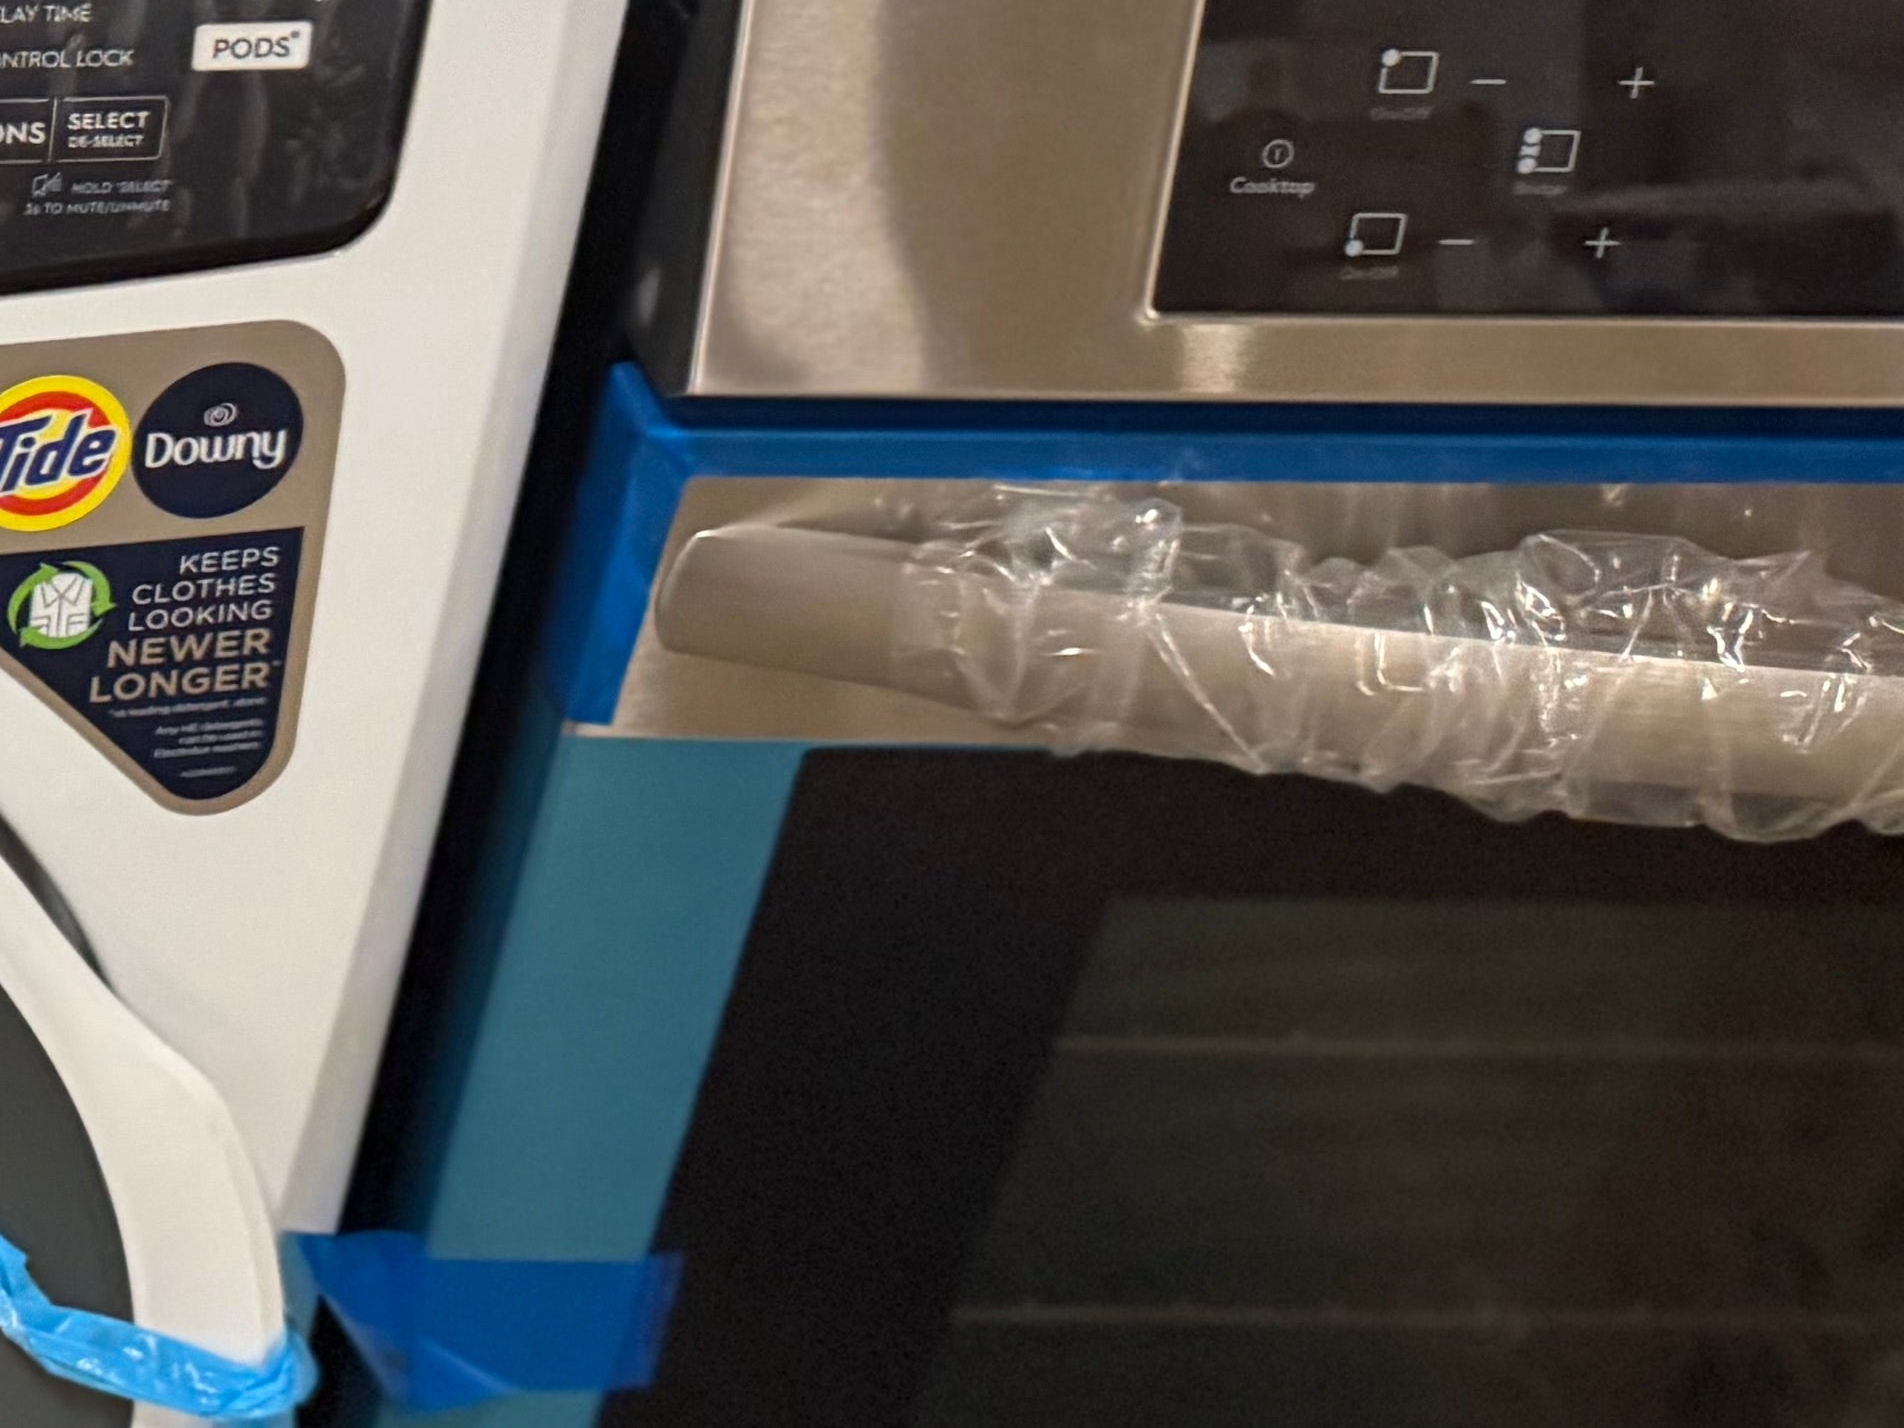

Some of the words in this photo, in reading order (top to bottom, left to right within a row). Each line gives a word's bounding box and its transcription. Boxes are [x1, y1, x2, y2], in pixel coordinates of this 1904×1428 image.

[43, 3, 93, 22] TIME
[76, 49, 135, 68] LOCK
[67, 110, 152, 131] SELECT
[145, 429, 288, 470] Downy
[180, 546, 281, 575] KEEPS
[132, 573, 277, 605] CLOTHES
[128, 599, 273, 632] LOOKING
[107, 628, 272, 668] NEWER
